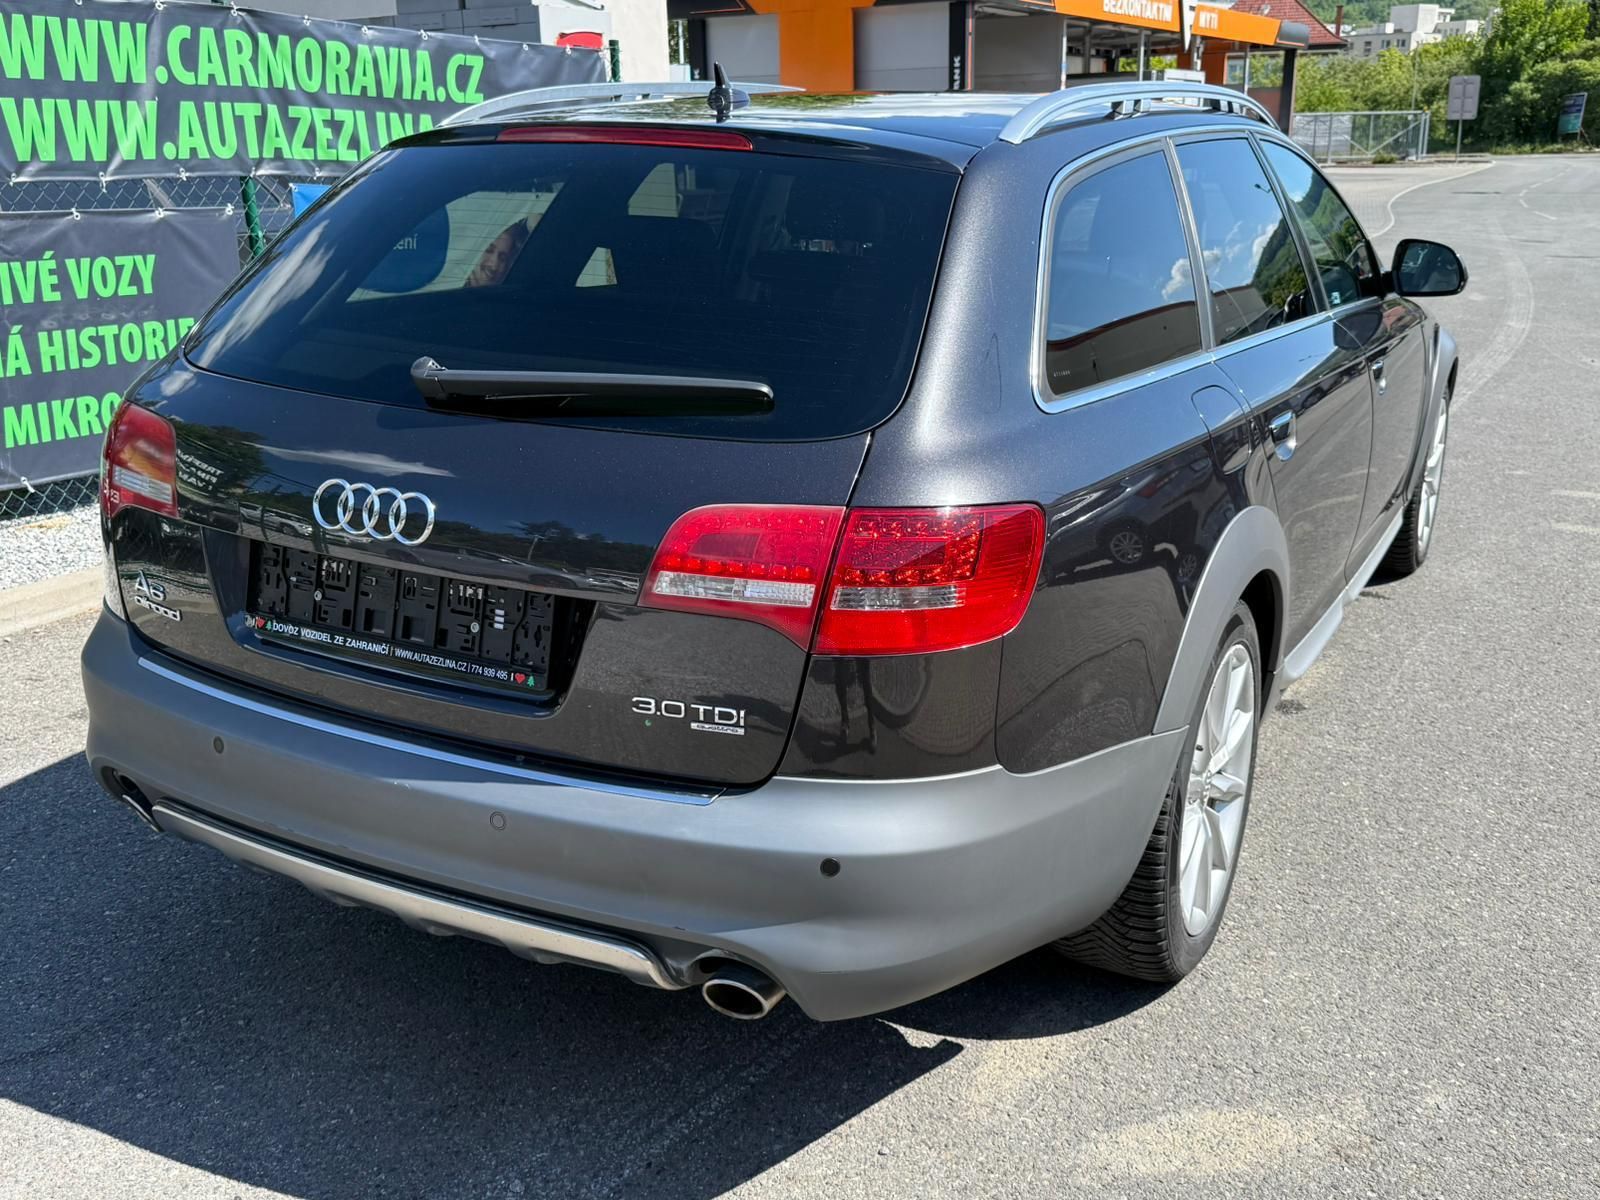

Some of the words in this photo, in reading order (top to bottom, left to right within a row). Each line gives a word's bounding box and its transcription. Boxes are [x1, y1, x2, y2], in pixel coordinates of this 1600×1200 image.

[0, 12, 484, 104] WWW.CARMORAVIA.CZ
[64, 254, 156, 300] VOZY
[135, 570, 165, 601] A6
[273, 622, 299, 636] DOVOZ
[301, 627, 332, 643] VOZIDEL
[334, 635, 344, 645] ZE
[346, 637, 389, 655] ZAHRANIČÍ
[395, 648, 466, 672] WWW.AUTAZEZLINA.CZ
[471, 664, 483, 675] 774
[631, 697, 685, 718] 3.0
[690, 704, 745, 726] TDI
